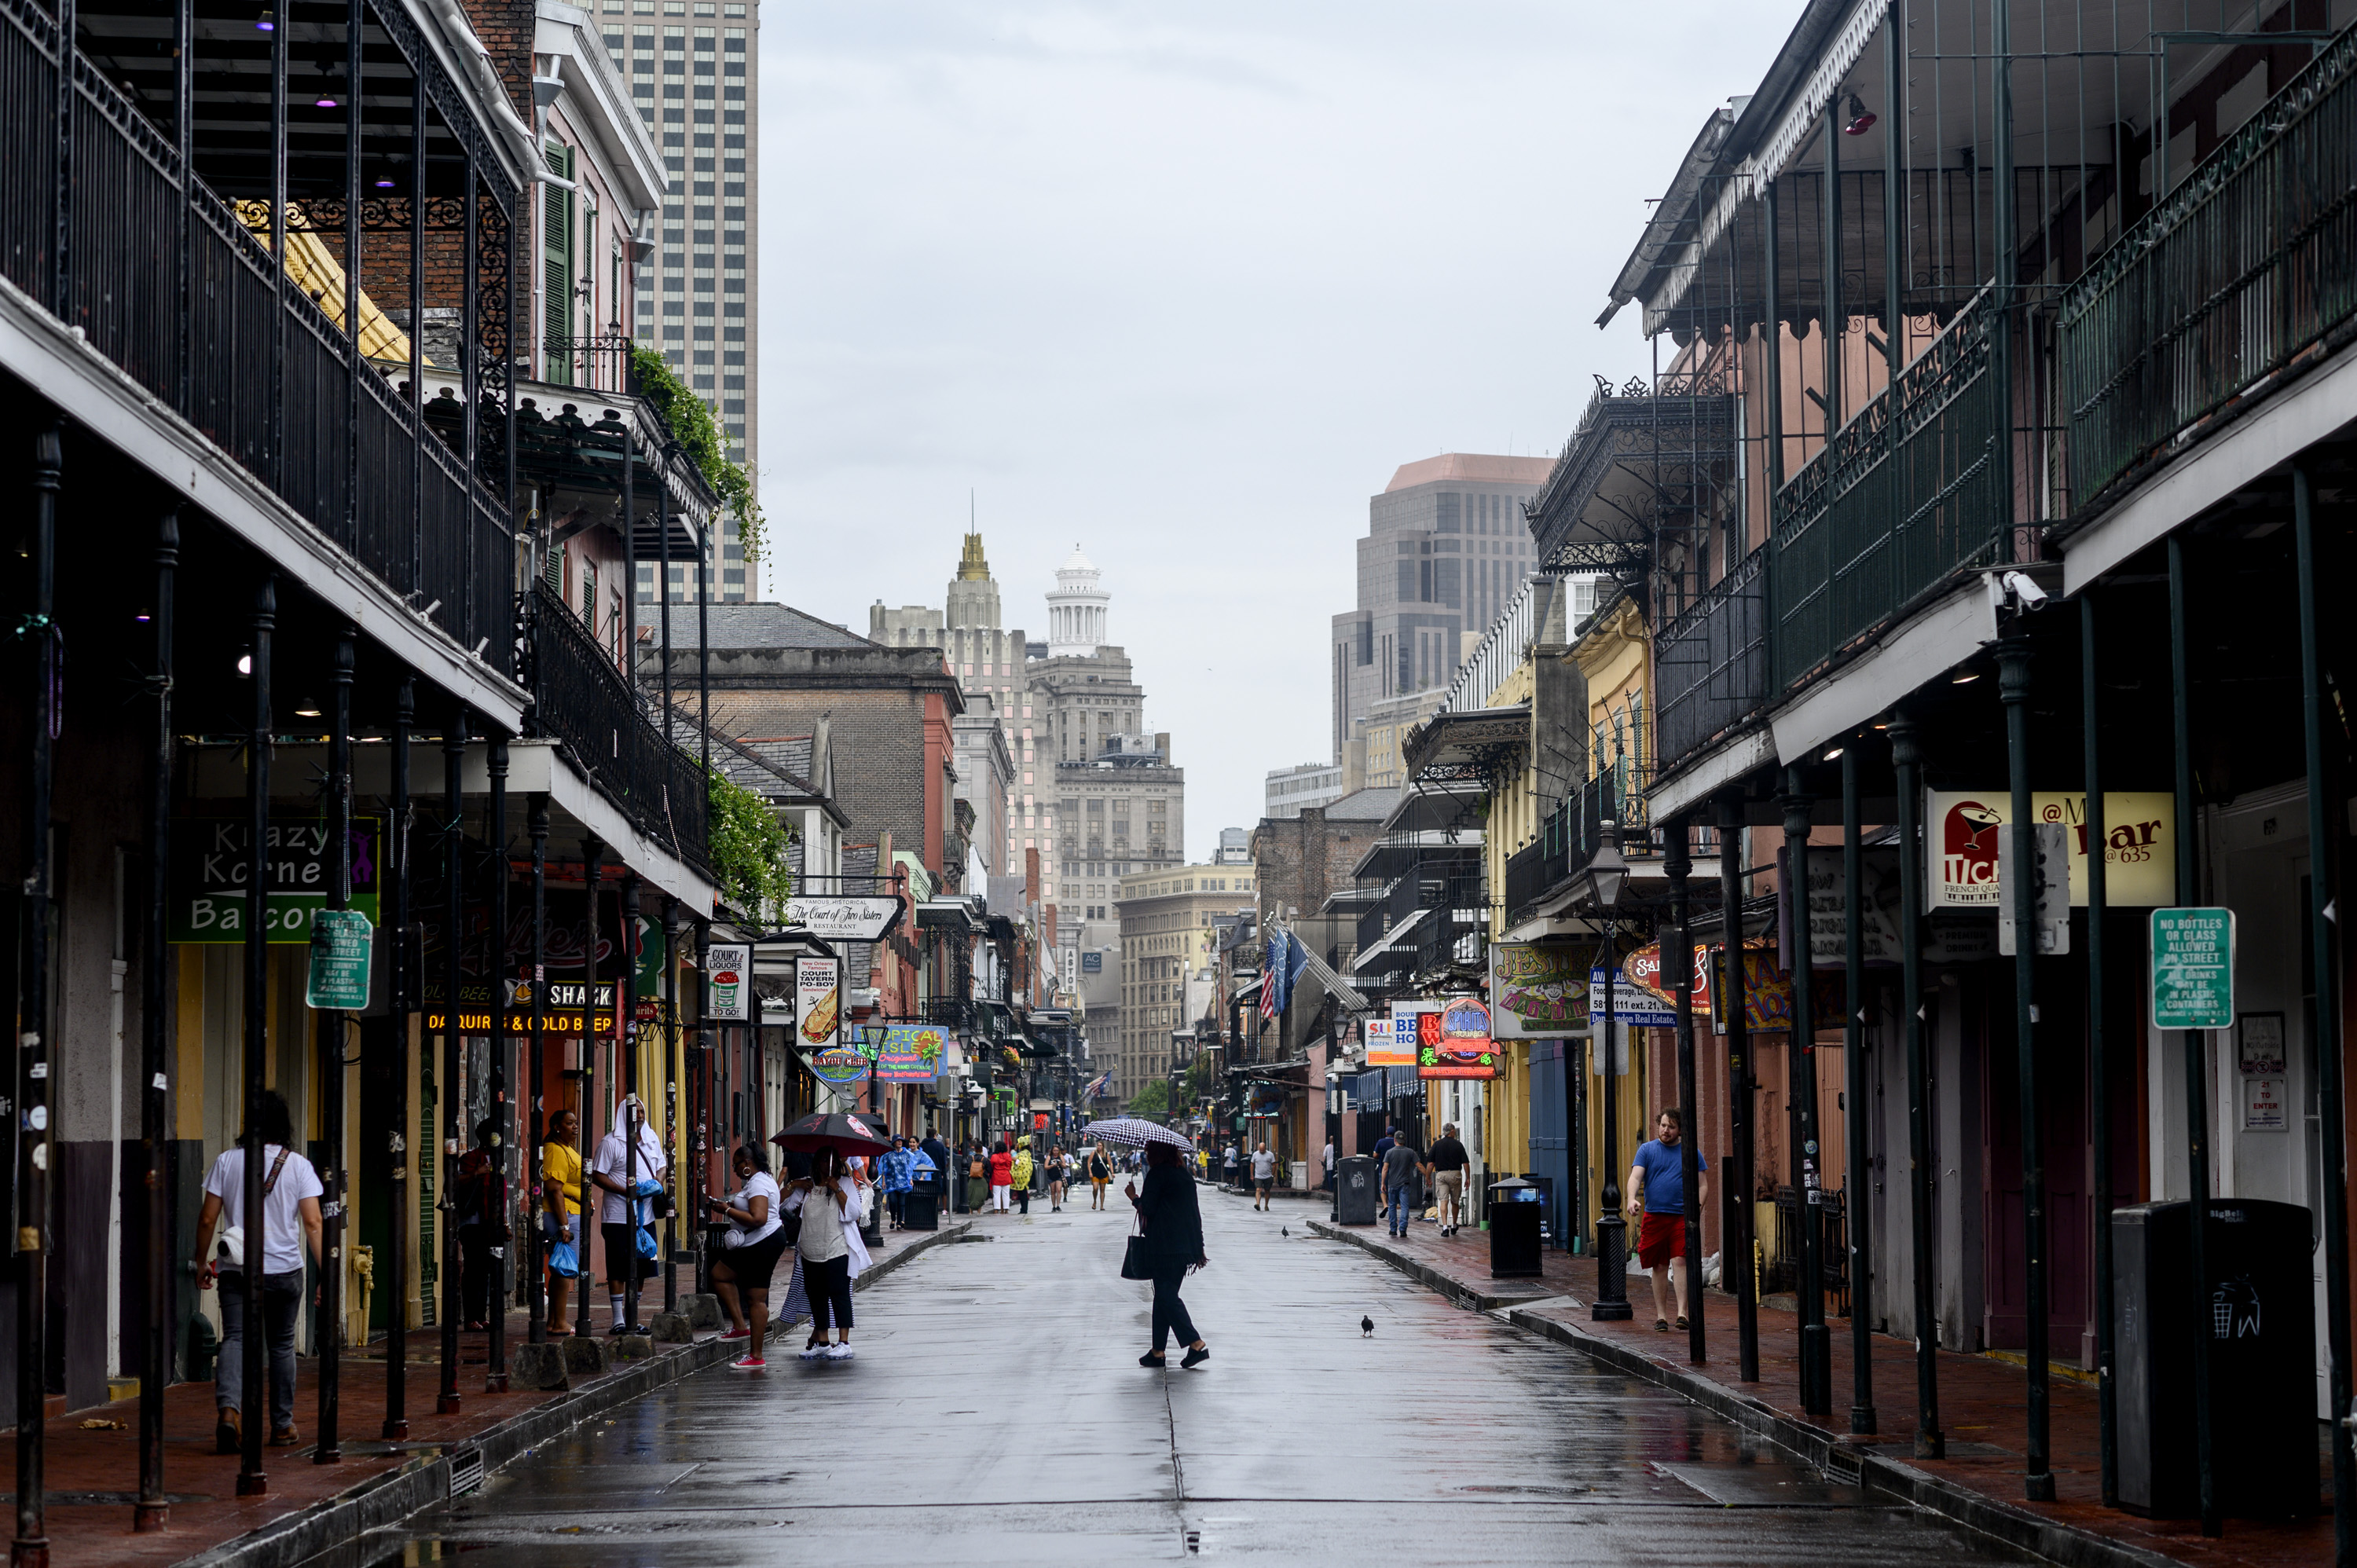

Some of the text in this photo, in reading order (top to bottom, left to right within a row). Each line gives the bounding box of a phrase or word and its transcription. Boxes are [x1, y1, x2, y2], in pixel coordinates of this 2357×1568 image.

[2121, 846, 2151, 863] 635
[203, 853, 321, 883] Kone
[1808, 873, 1835, 890] EW
[1981, 885, 2000, 893] QUA
[1809, 896, 1872, 912] RLEAS
[791, 905, 882, 923] The Court of Two Sisters
[1810, 918, 1881, 933] RIGIAL
[2160, 918, 2223, 929] NO BOTTLES
[332, 929, 360, 938] GLASS
[2166, 930, 2217, 940] OR GLASS
[331, 947, 361, 956] STREET
[2168, 942, 2216, 952] ALLOWED
[713, 950, 739, 961] COURT
[2164, 953, 2220, 963] ON STREET
[1526, 974, 1555, 986] MARDI
[2198, 980, 2208, 989] BE
[460, 987, 490, 1000] BEE
[550, 985, 613, 1006] SHAK
[1614, 987, 1636, 997] everage,
[2181, 990, 2215, 998] PLASTIC
[1503, 995, 1588, 1019] DAIQUIR
[1648, 1001, 1659, 1011] 21,
[2166, 1000, 2219, 1009] CONTAINERS
[429, 1015, 508, 1029] DAQUIR
[512, 1017, 523, 1030] &
[574, 1017, 612, 1031] BER
[1447, 1011, 1487, 1031] SPIRITS
[1614, 1013, 1633, 1023] andon
[1635, 1014, 1650, 1024] Real
[1652, 1015, 1675, 1024] Estate,
[1523, 1021, 1549, 1030] AND
[858, 1029, 941, 1041] TROPICAL
[880, 1042, 921, 1053] ISLE
[812, 1057, 868, 1065] BAYOU CLUB
[879, 1053, 918, 1064] Original
